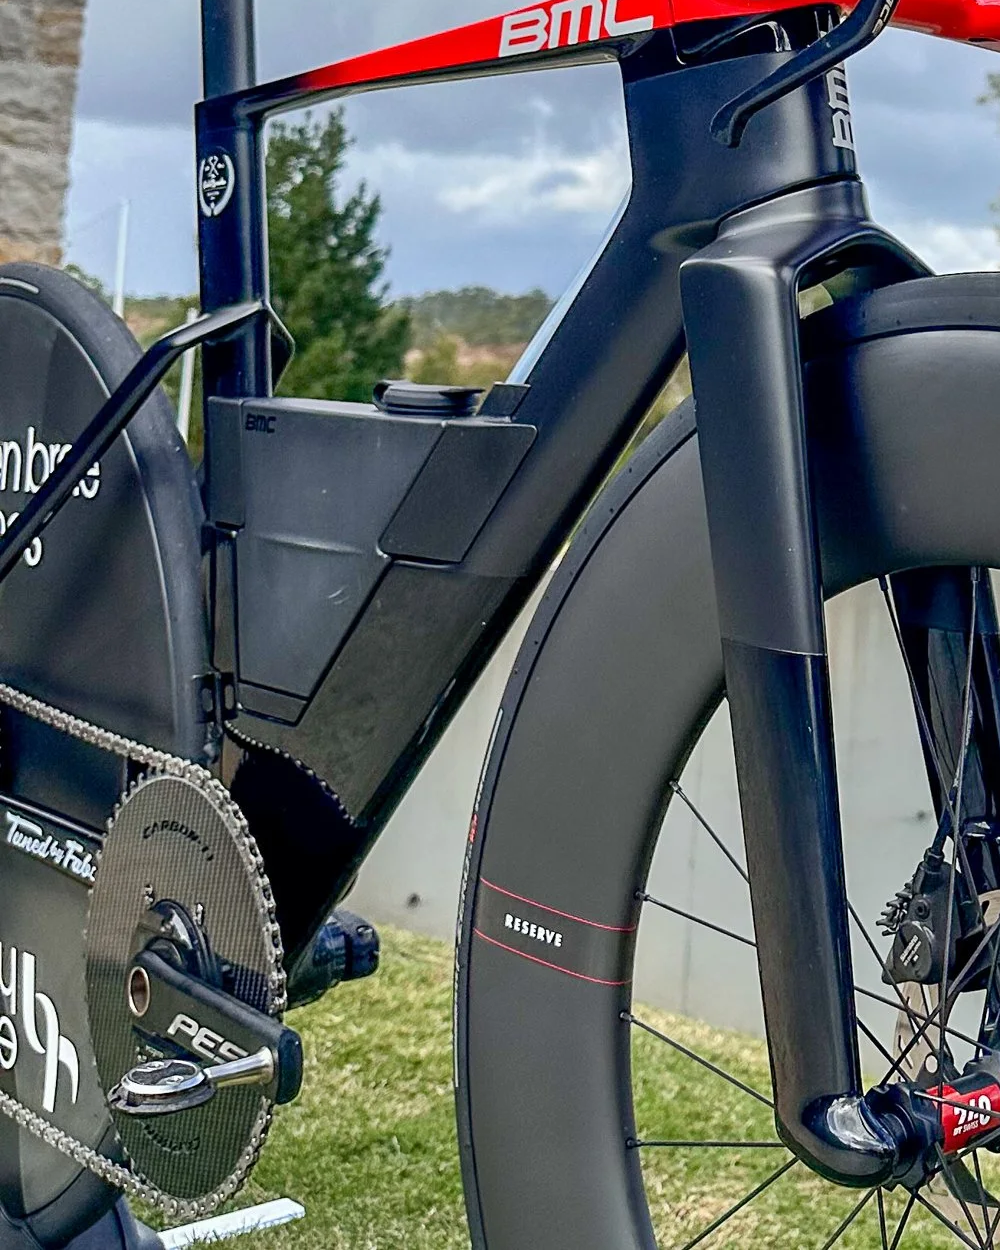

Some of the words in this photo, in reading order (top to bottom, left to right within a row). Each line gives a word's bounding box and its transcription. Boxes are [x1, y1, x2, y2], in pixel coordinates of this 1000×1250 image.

[826, 61, 855, 150] BM
[245, 413, 277, 434] BMC
[6, 810, 53, 858] Tuned
[50, 841, 65, 864] by
[504, 913, 564, 948] RESERVE
